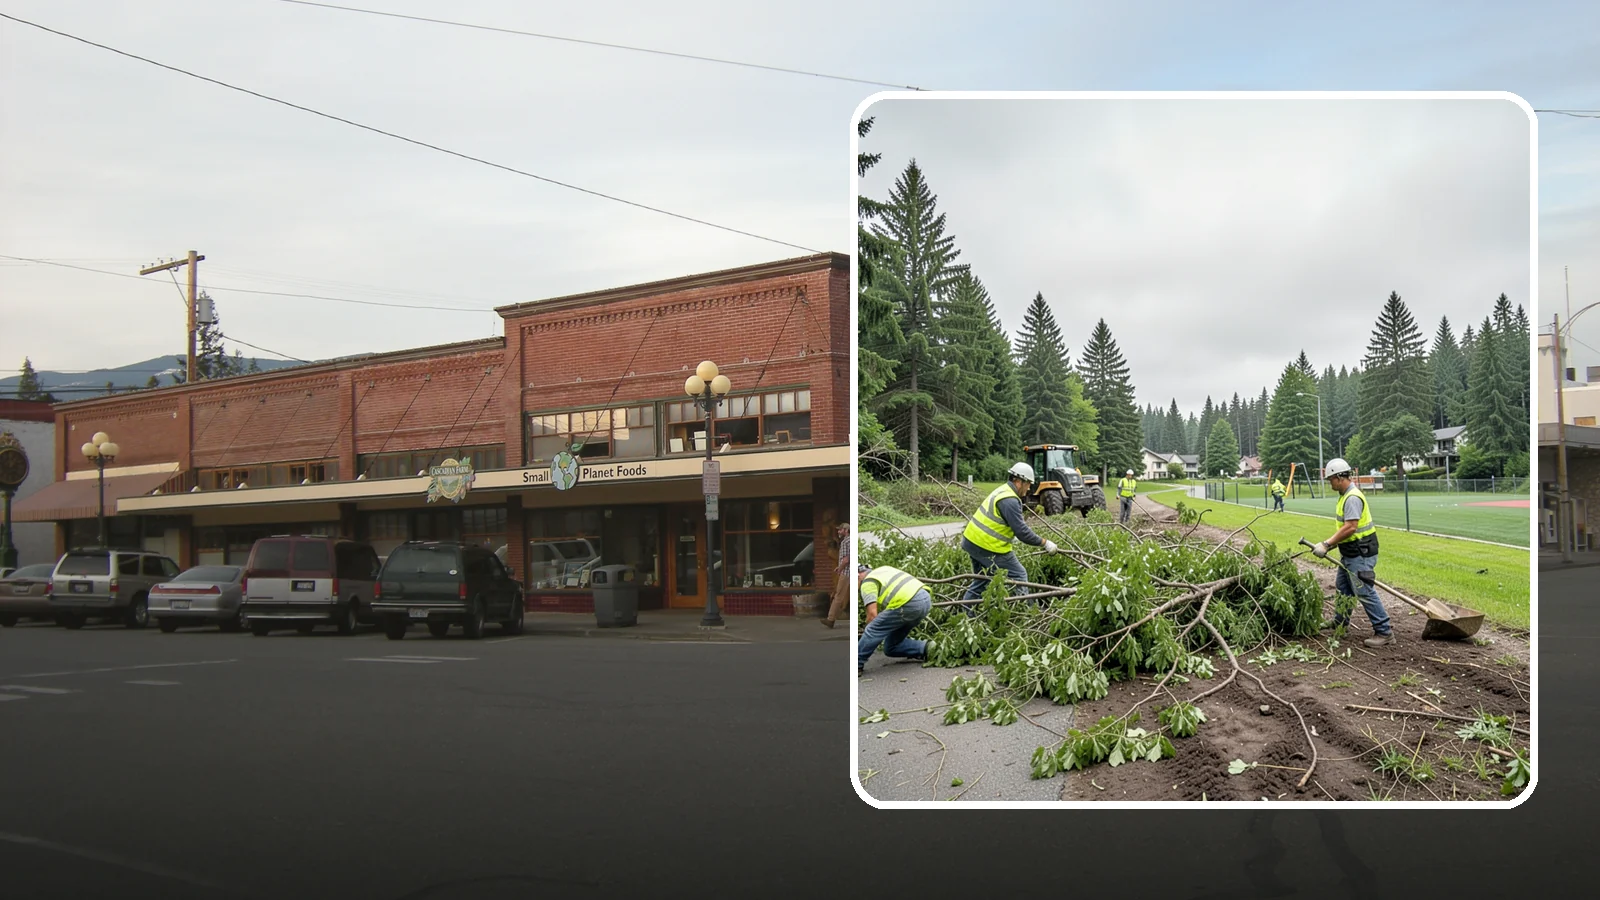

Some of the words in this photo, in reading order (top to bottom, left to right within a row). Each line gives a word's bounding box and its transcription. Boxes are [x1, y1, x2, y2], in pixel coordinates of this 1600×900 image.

[523, 471, 549, 483] Small
[582, 467, 614, 479] Planet
[616, 464, 647, 477] Foods
